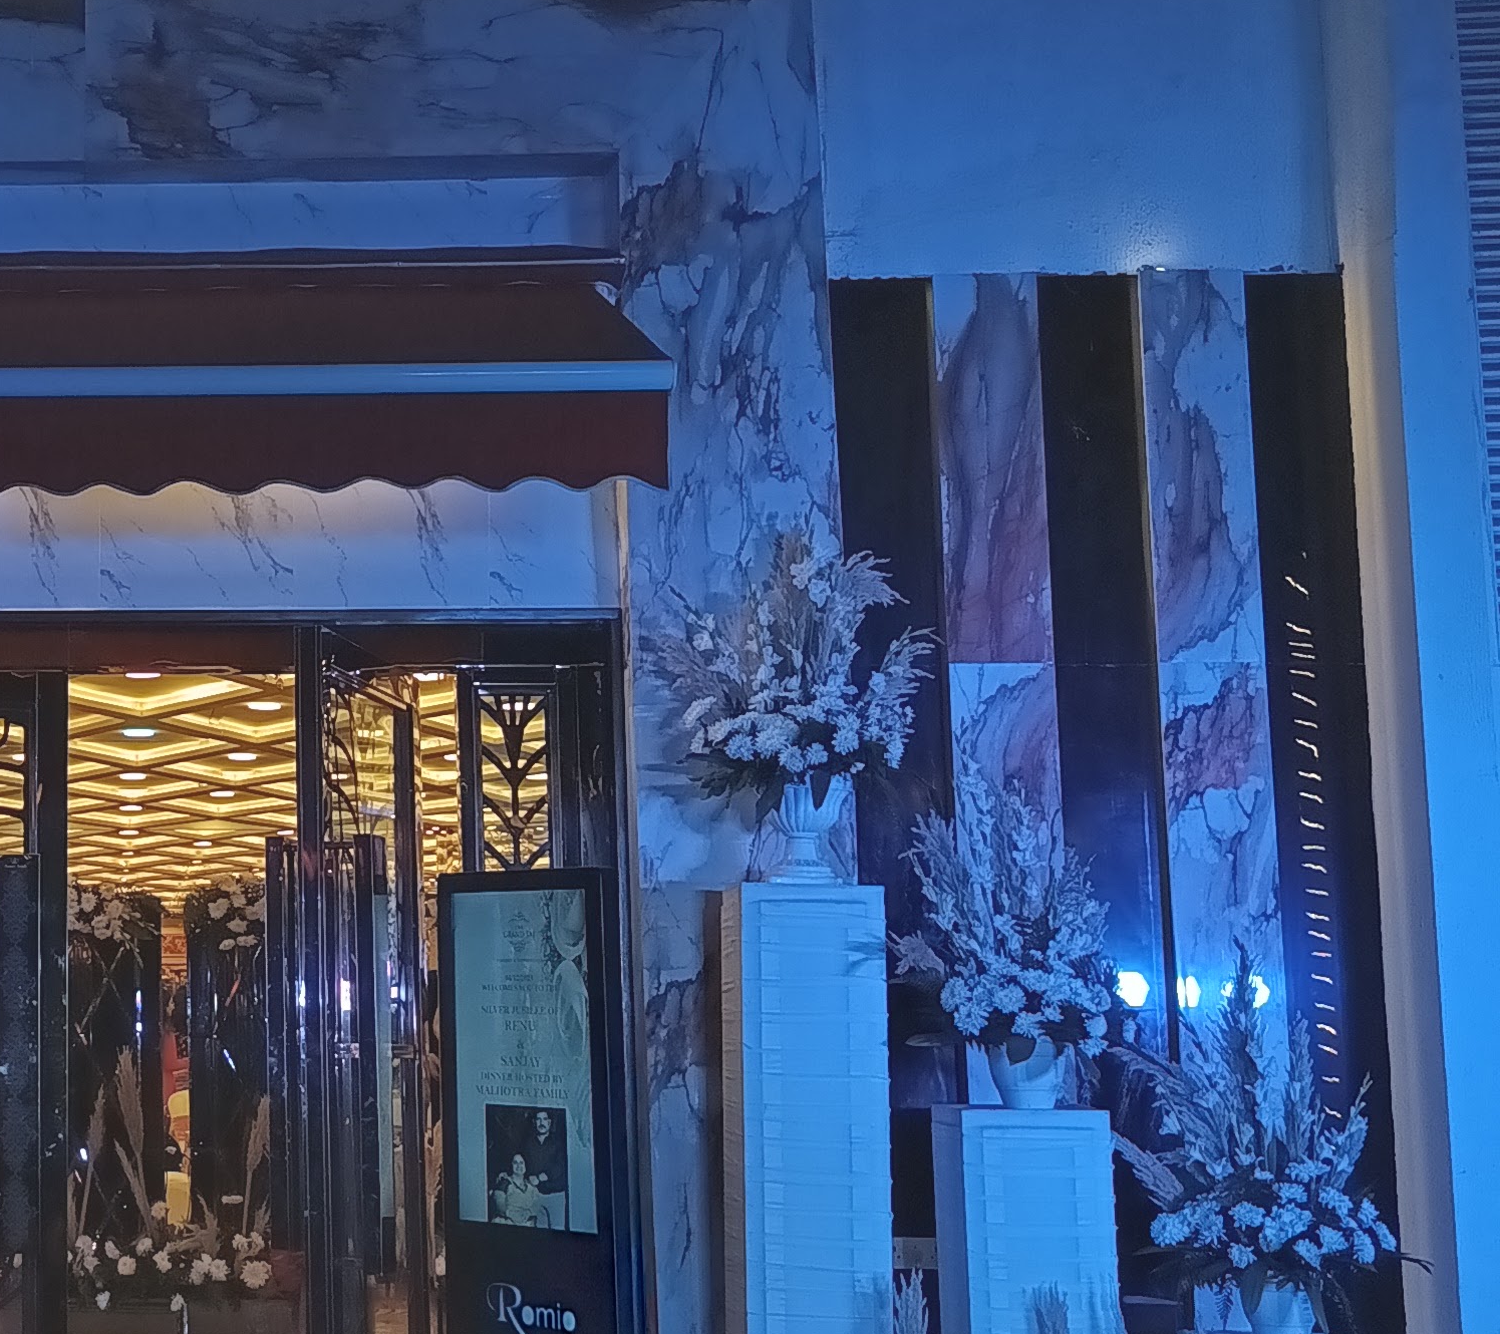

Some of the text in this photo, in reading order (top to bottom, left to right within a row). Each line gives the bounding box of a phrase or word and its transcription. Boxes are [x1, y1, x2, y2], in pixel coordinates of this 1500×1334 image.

[504, 1019, 536, 1032] RENU
[500, 1055, 543, 1068] SANJAY
[480, 1071, 565, 1085] DINNER HOSTED BY
[475, 1084, 571, 1100] MALHOTRA FAMILY
